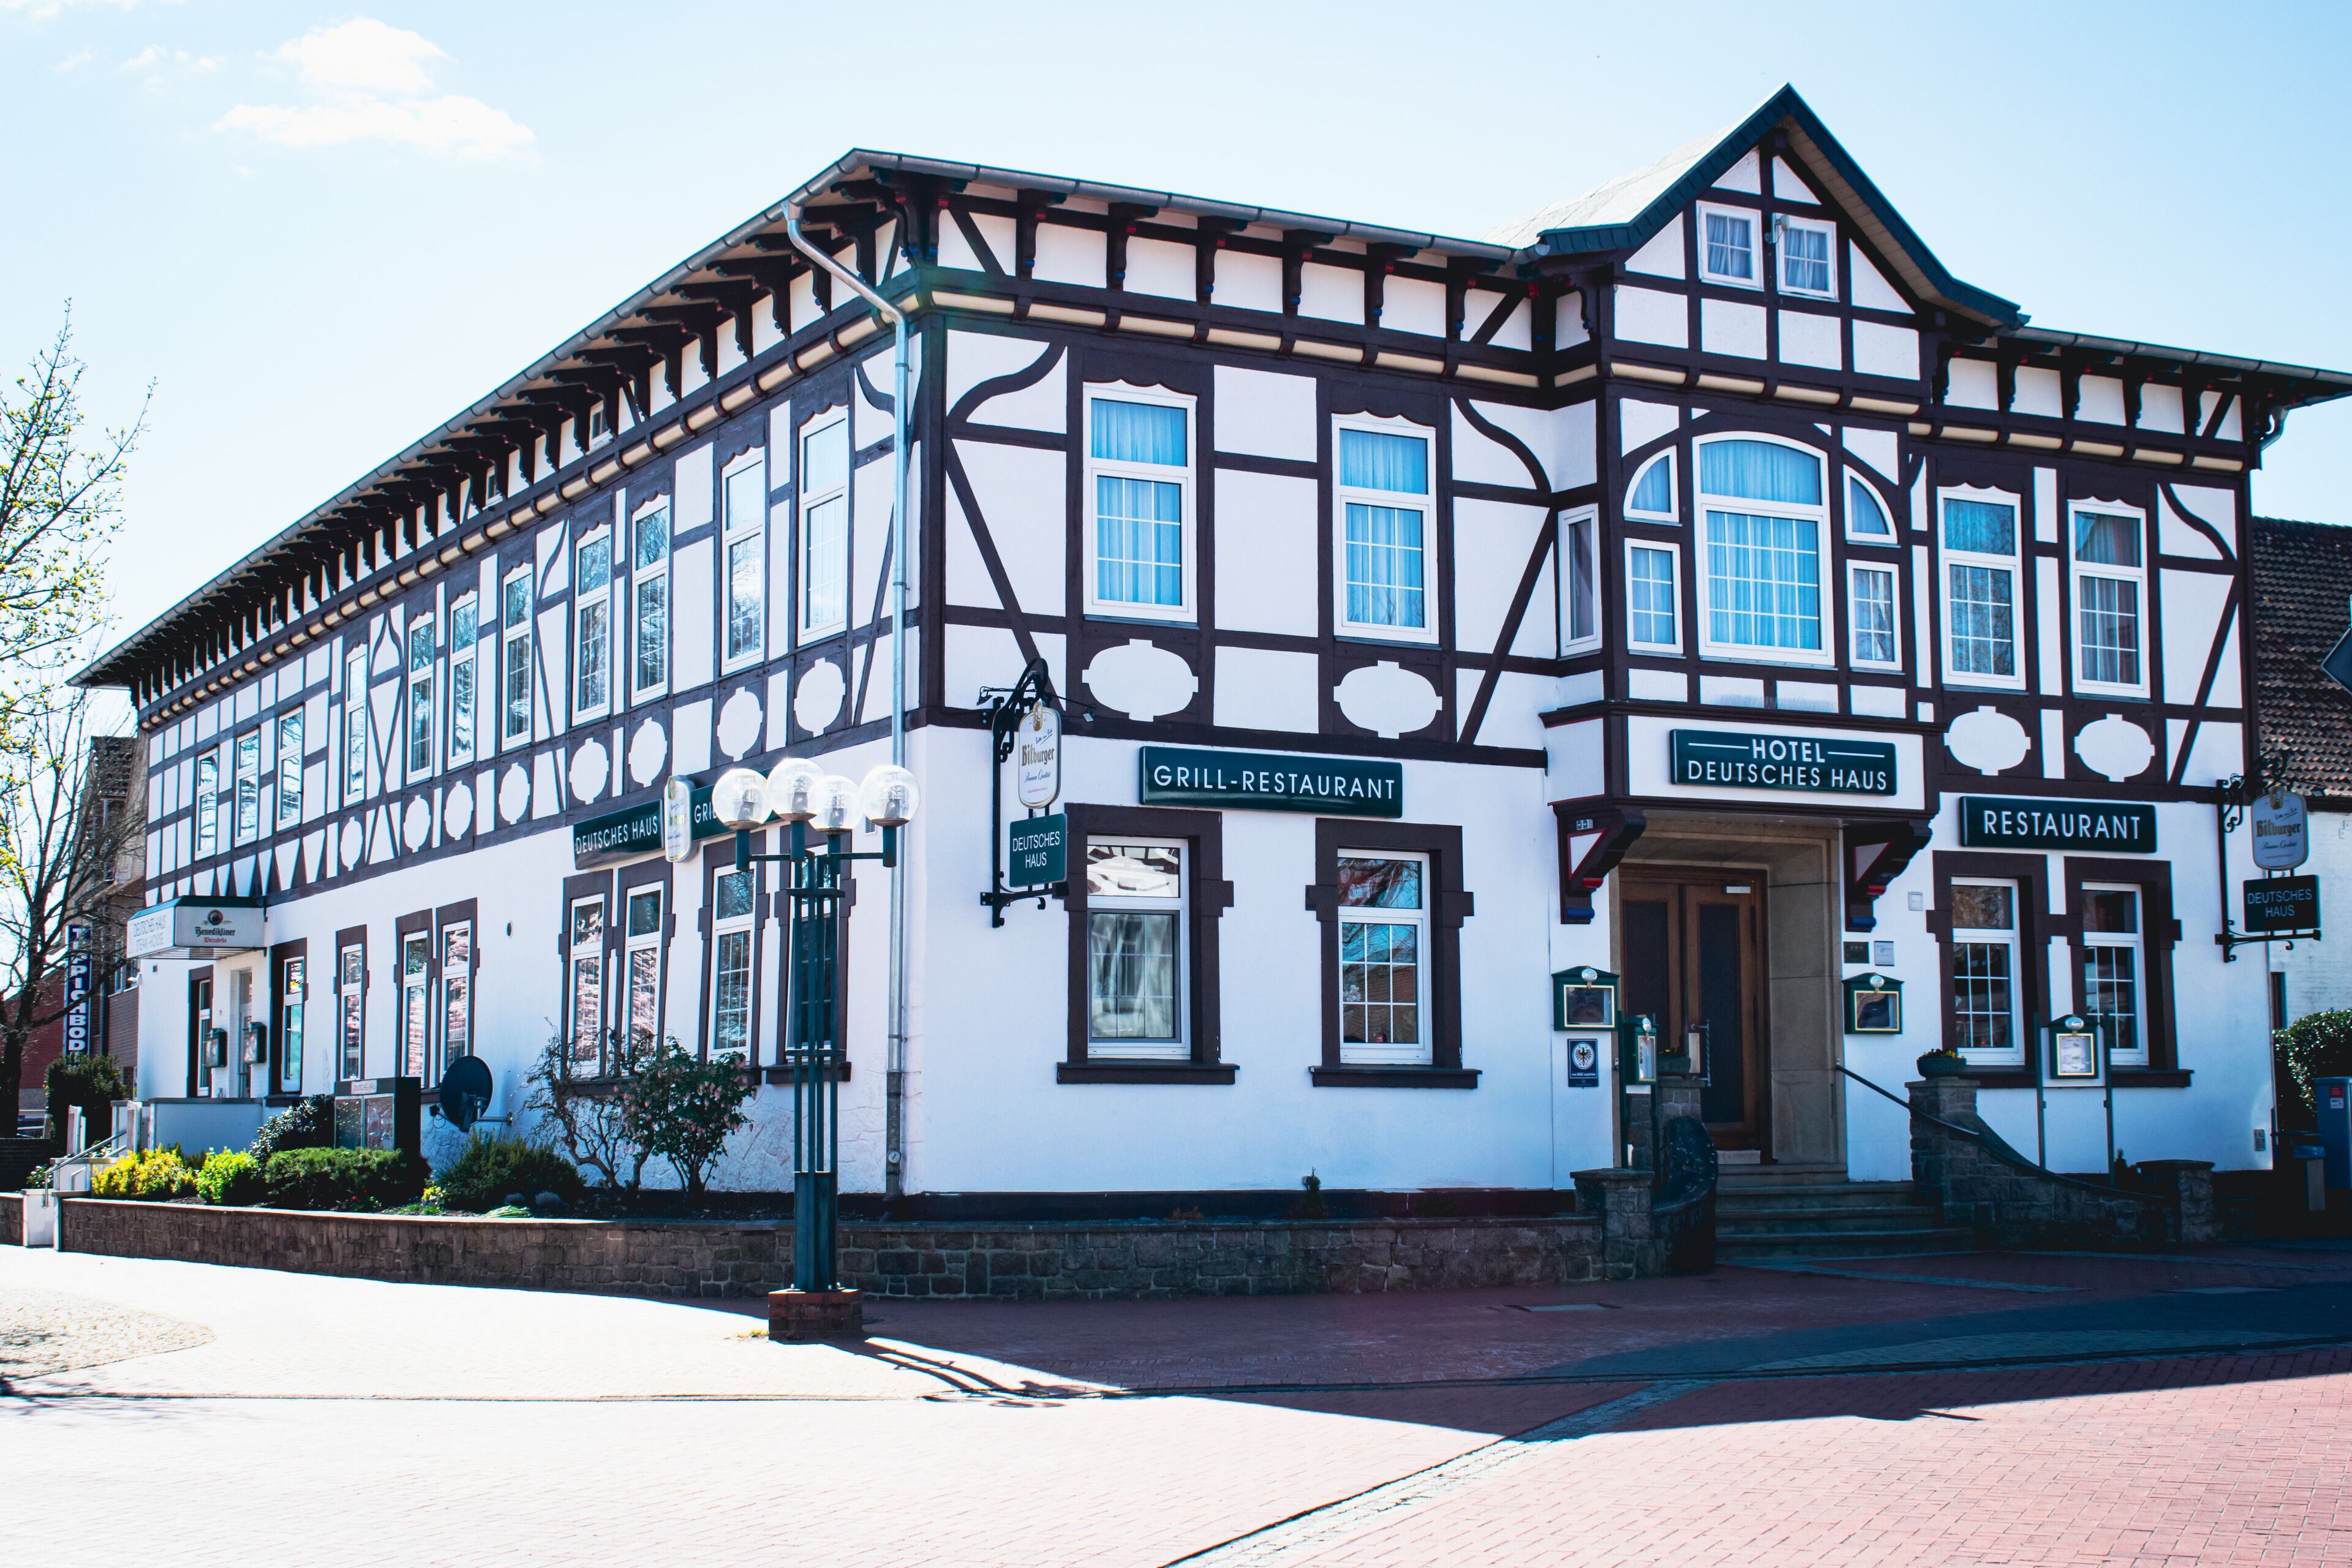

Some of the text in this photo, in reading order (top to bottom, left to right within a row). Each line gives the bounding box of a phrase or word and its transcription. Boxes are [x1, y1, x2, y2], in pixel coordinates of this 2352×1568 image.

[1022, 743, 1054, 766] Bitburger
[1752, 739, 1825, 763] HOTEL
[1154, 765, 1395, 799] GRILL-RESTAURANT
[1688, 760, 1887, 791] DEUTSCHES HAUS
[576, 824, 628, 854] DEUTSCHES
[632, 815, 658, 840] HAUS
[1983, 810, 2140, 840] RESTAURANT
[2256, 818, 2301, 837] Bitburger
[1012, 831, 1060, 851] DEUTSCHES
[1025, 852, 1047, 869] HAUS
[2247, 889, 2312, 904] DEUTSCHES
[2265, 905, 2294, 918] HAUS
[195, 926, 236, 937] Benediktiner
